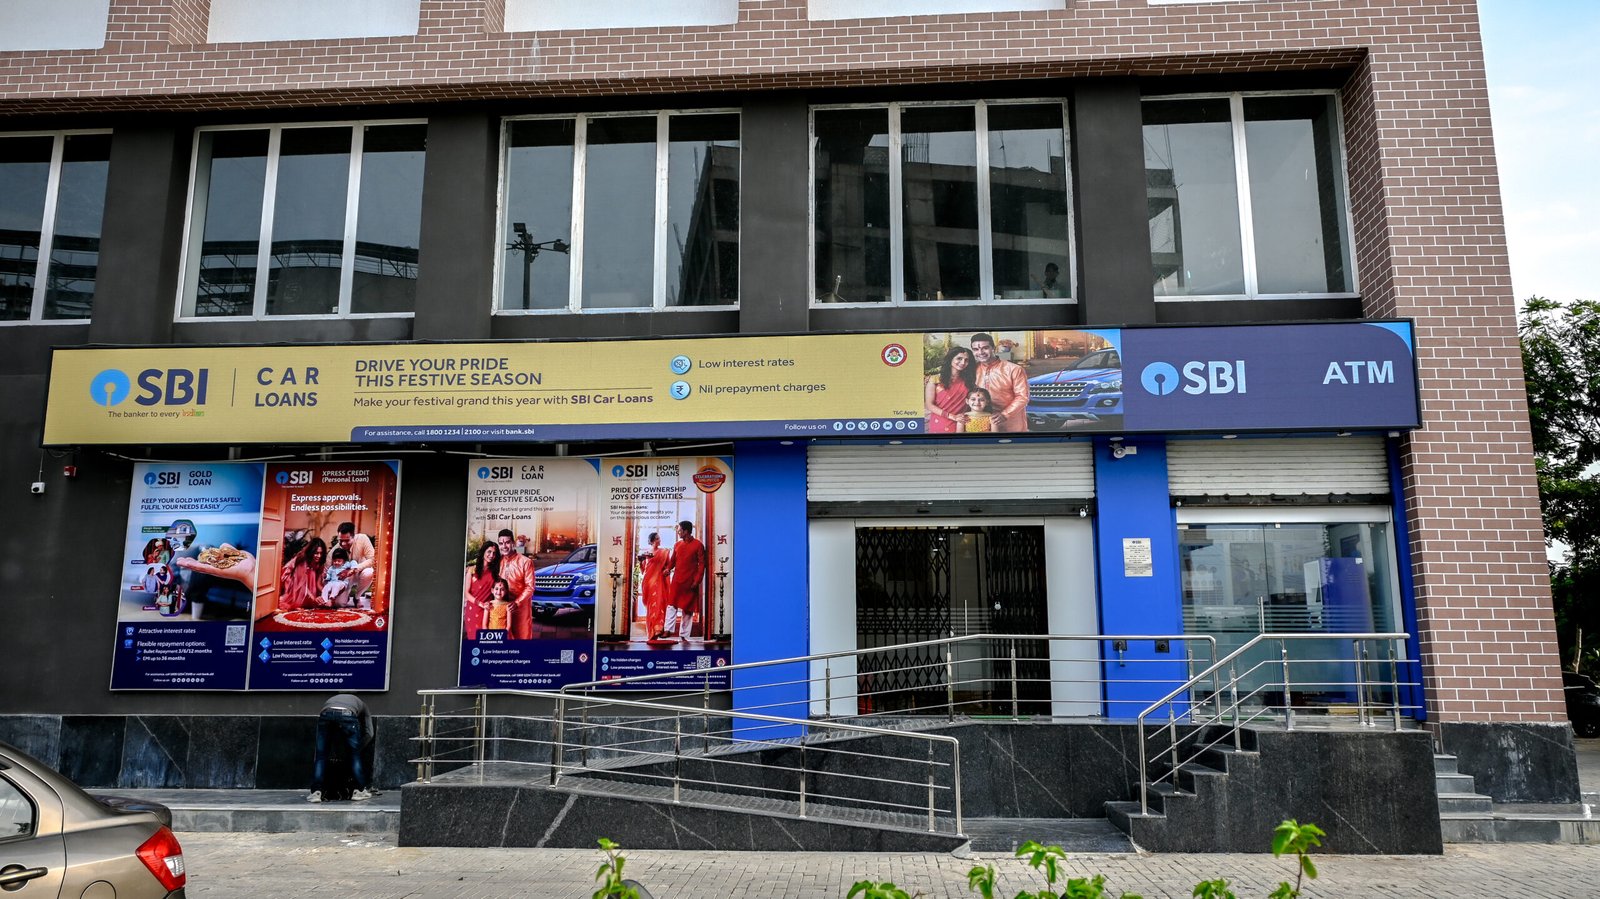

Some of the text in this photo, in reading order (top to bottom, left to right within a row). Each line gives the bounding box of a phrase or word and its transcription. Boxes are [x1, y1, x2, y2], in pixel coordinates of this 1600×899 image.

[355, 358, 508, 372] DRIVE YOUR PRIDE
[698, 358, 795, 369] Low interest rates
[256, 367, 319, 385] CAR
[1183, 360, 1246, 394] SBI
[1322, 360, 1394, 385] ATM
[355, 372, 542, 387] THIS FESTIVE SEASON
[134, 368, 209, 406] SBI
[699, 382, 826, 395] Nil prepayment charges
[255, 392, 318, 407] LOANS
[354, 394, 654, 409] Make your festival grand this year with SBI Car Loans
[290, 471, 313, 484] SBI
[491, 466, 513, 479] SBI
[626, 465, 648, 477] SBI
[158, 472, 181, 484] SBI
[292, 493, 362, 503] Express approvals.
[321, 503, 368, 512] possibilities.
[480, 632, 504, 640] LOW
